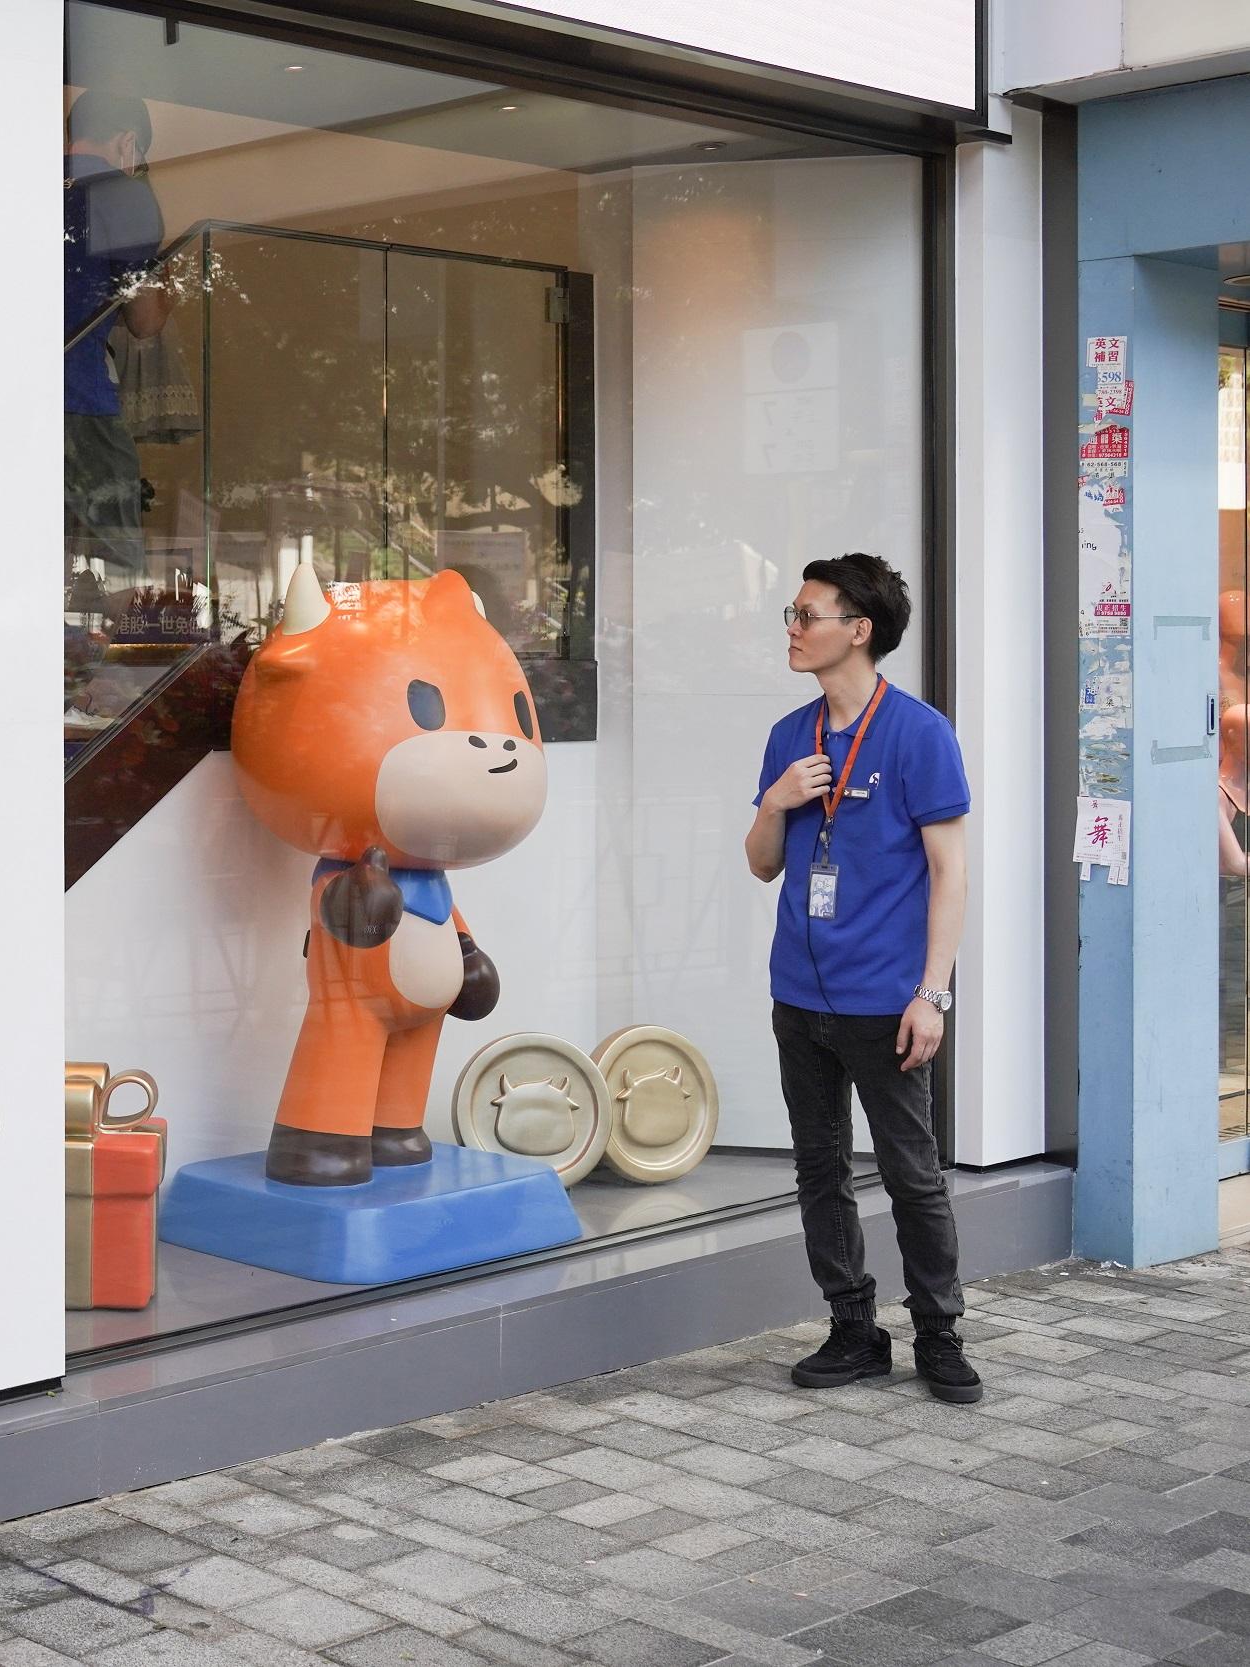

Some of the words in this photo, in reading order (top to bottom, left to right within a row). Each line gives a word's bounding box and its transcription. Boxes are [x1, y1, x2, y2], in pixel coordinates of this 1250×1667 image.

[1094, 337, 1120, 350] 英文
[1094, 350, 1119, 362] 補習
[1086, 815, 1111, 849] 舞
